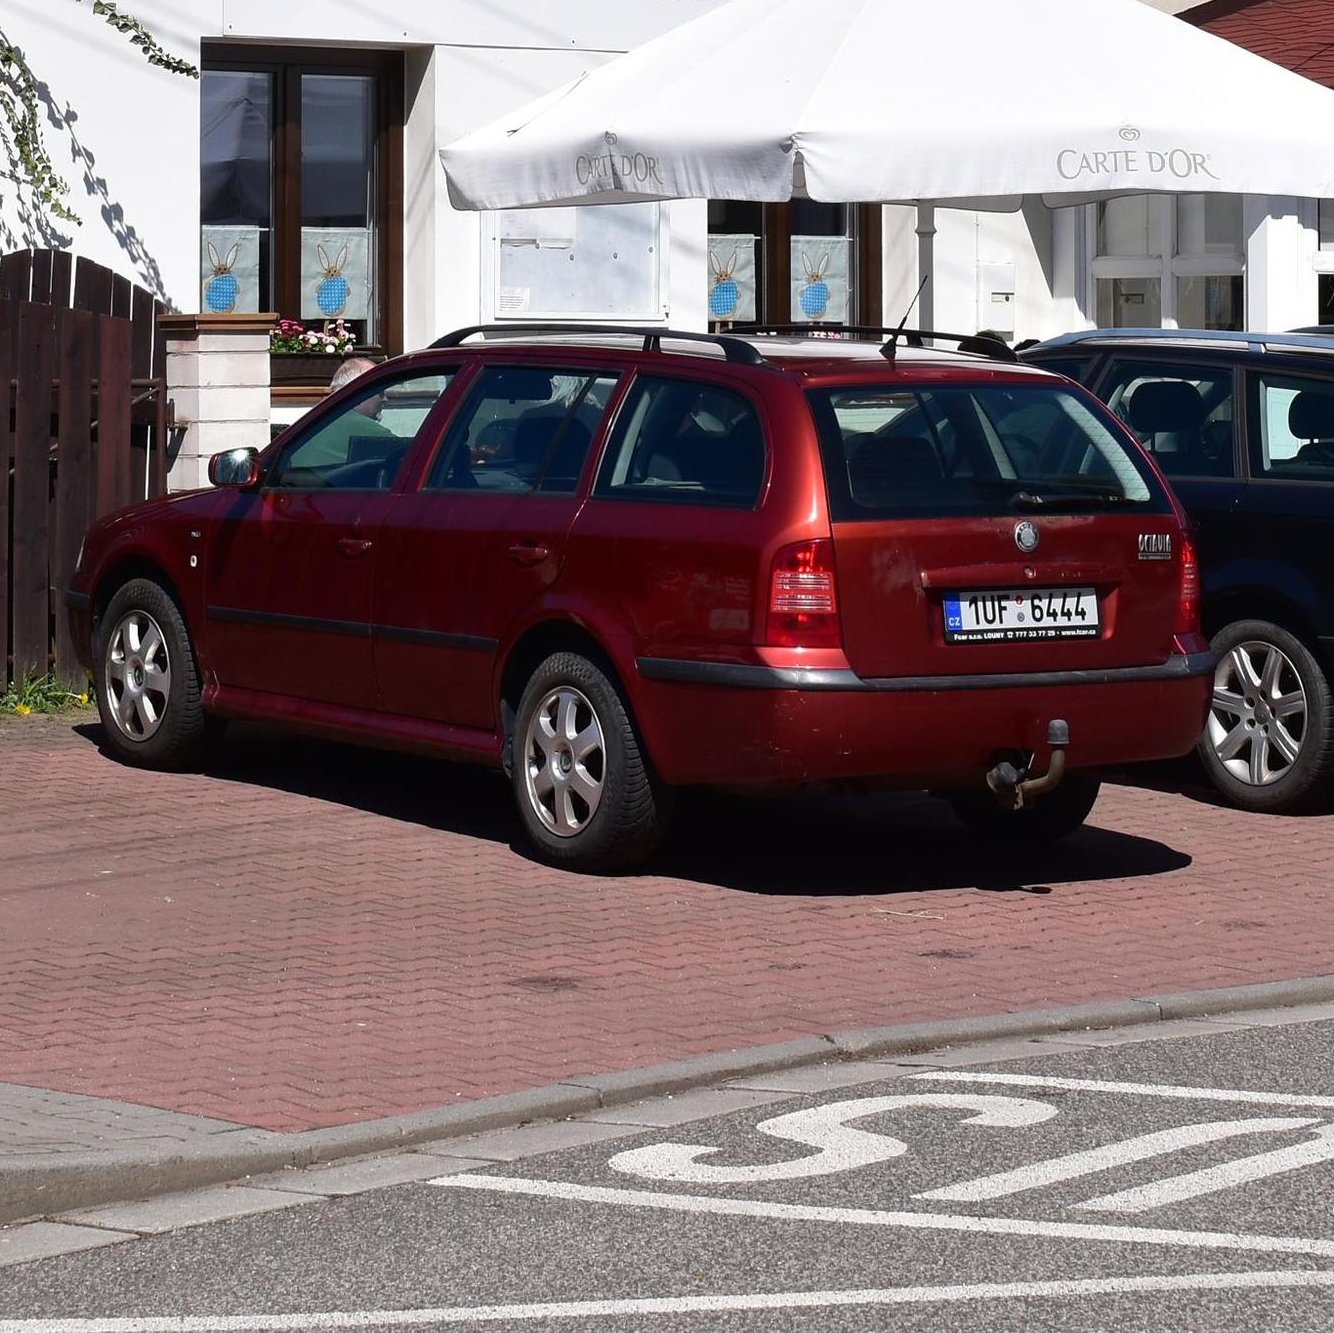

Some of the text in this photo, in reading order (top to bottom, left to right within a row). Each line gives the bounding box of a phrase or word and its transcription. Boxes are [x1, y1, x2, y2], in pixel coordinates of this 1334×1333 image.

[575, 154, 616, 185] CART
[1057, 149, 1139, 179] CARTE
[1138, 534, 1171, 552] OCTAVIA
[948, 592, 1087, 627] CZ 1UF 6444
